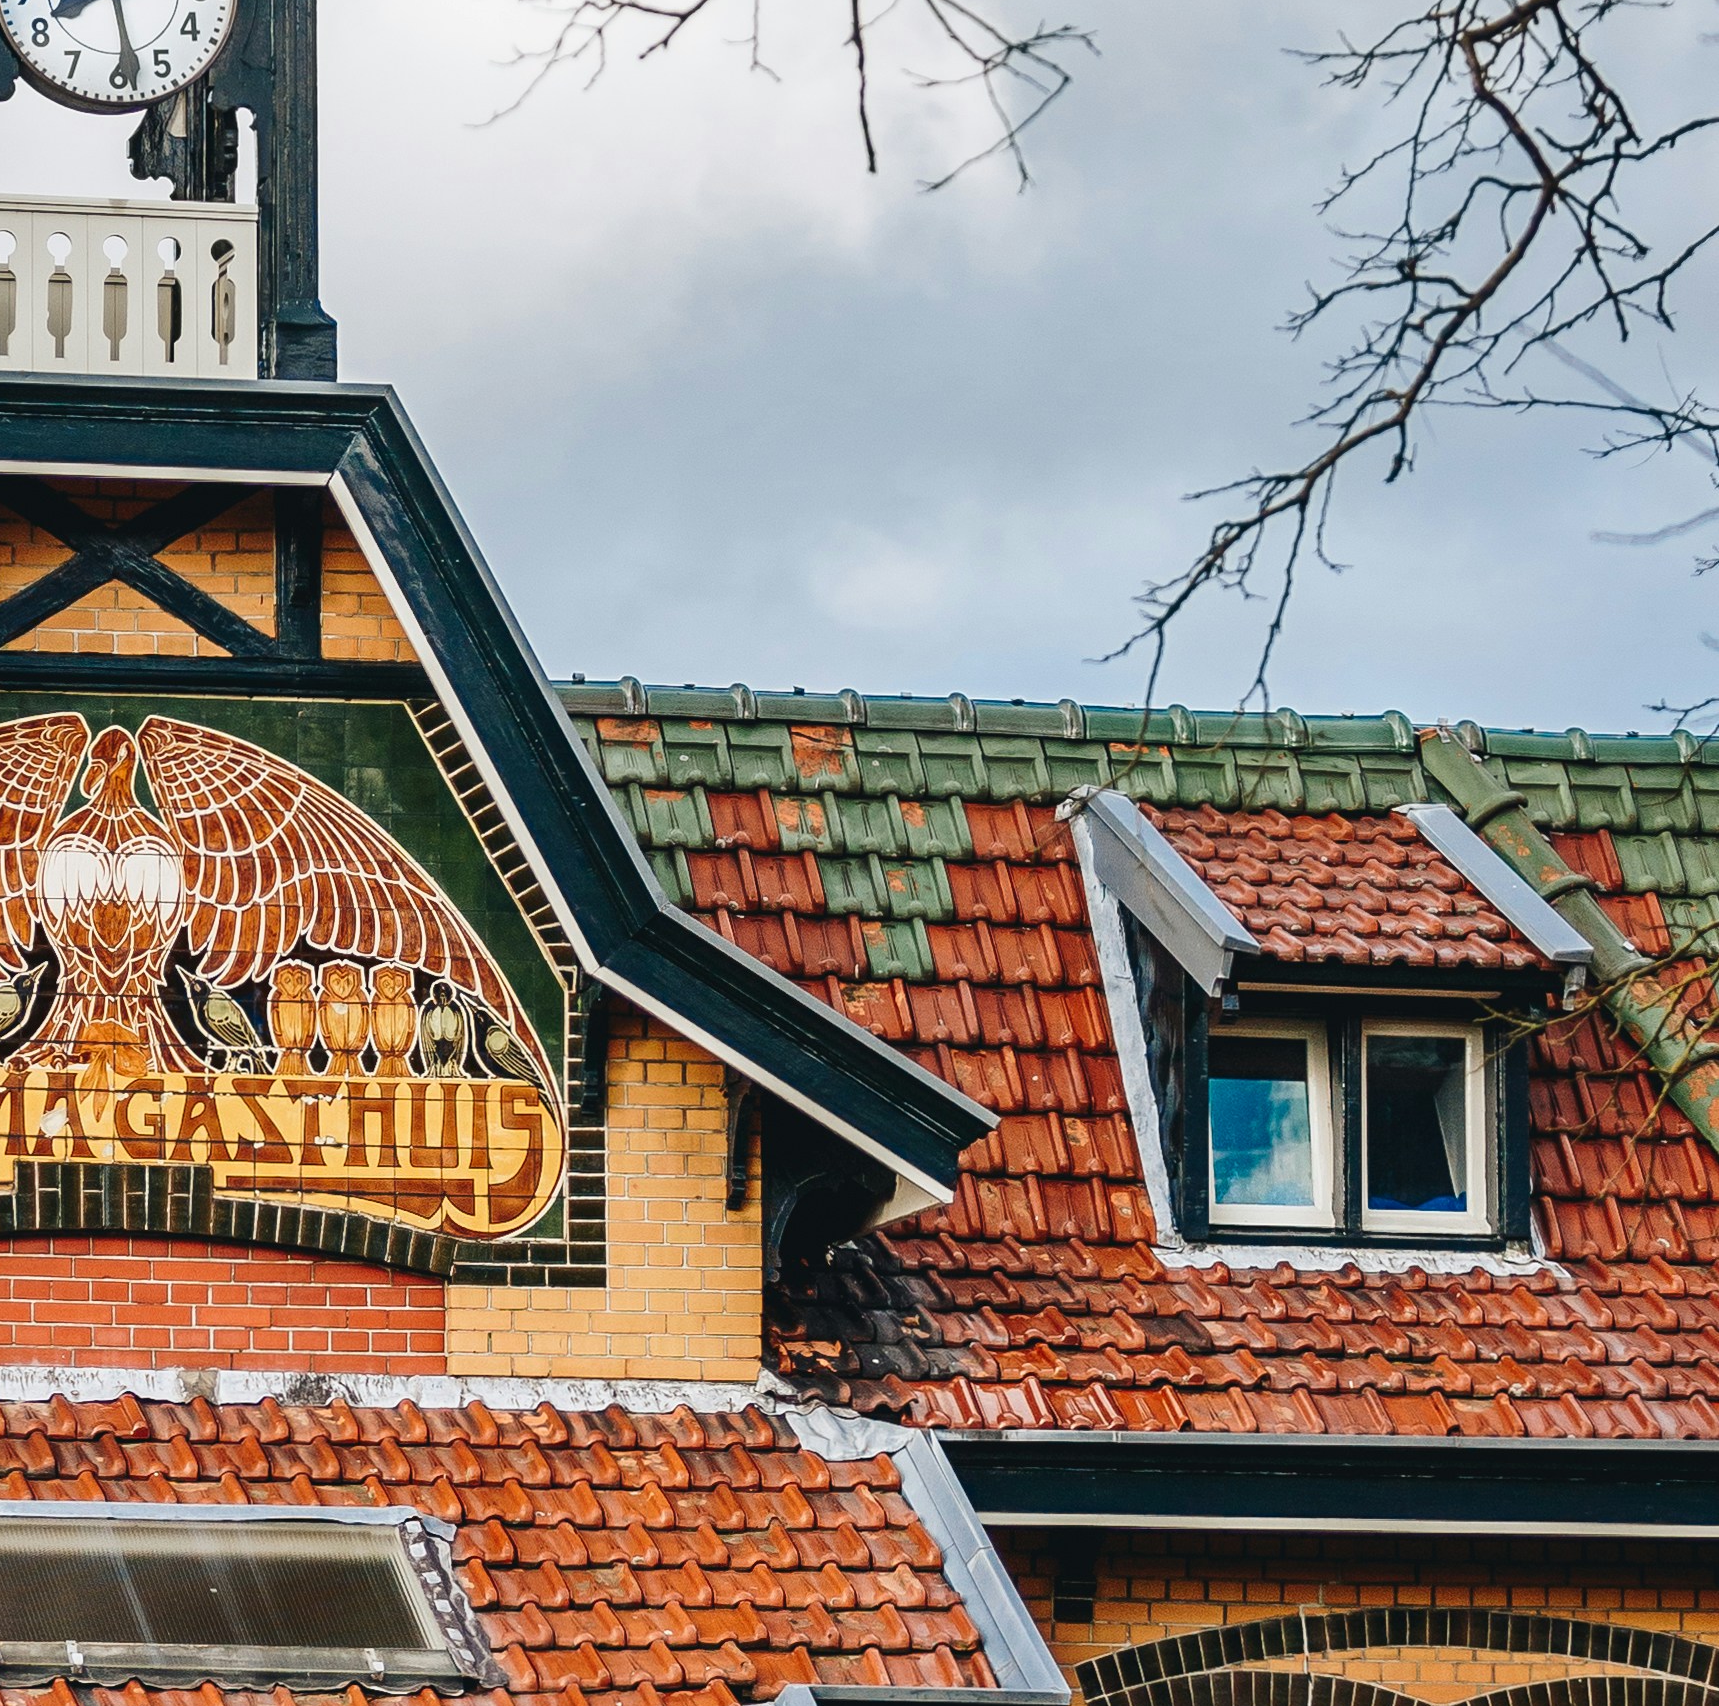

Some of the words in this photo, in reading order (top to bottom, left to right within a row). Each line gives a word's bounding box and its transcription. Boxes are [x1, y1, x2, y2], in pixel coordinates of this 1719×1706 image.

[31, 18, 50, 48] 8
[180, 11, 201, 42] 4
[64, 50, 82, 79] 7
[108, 60, 129, 90] 6
[153, 49, 171, 78] 5
[114, 1077, 542, 1225] GASTHUIS
